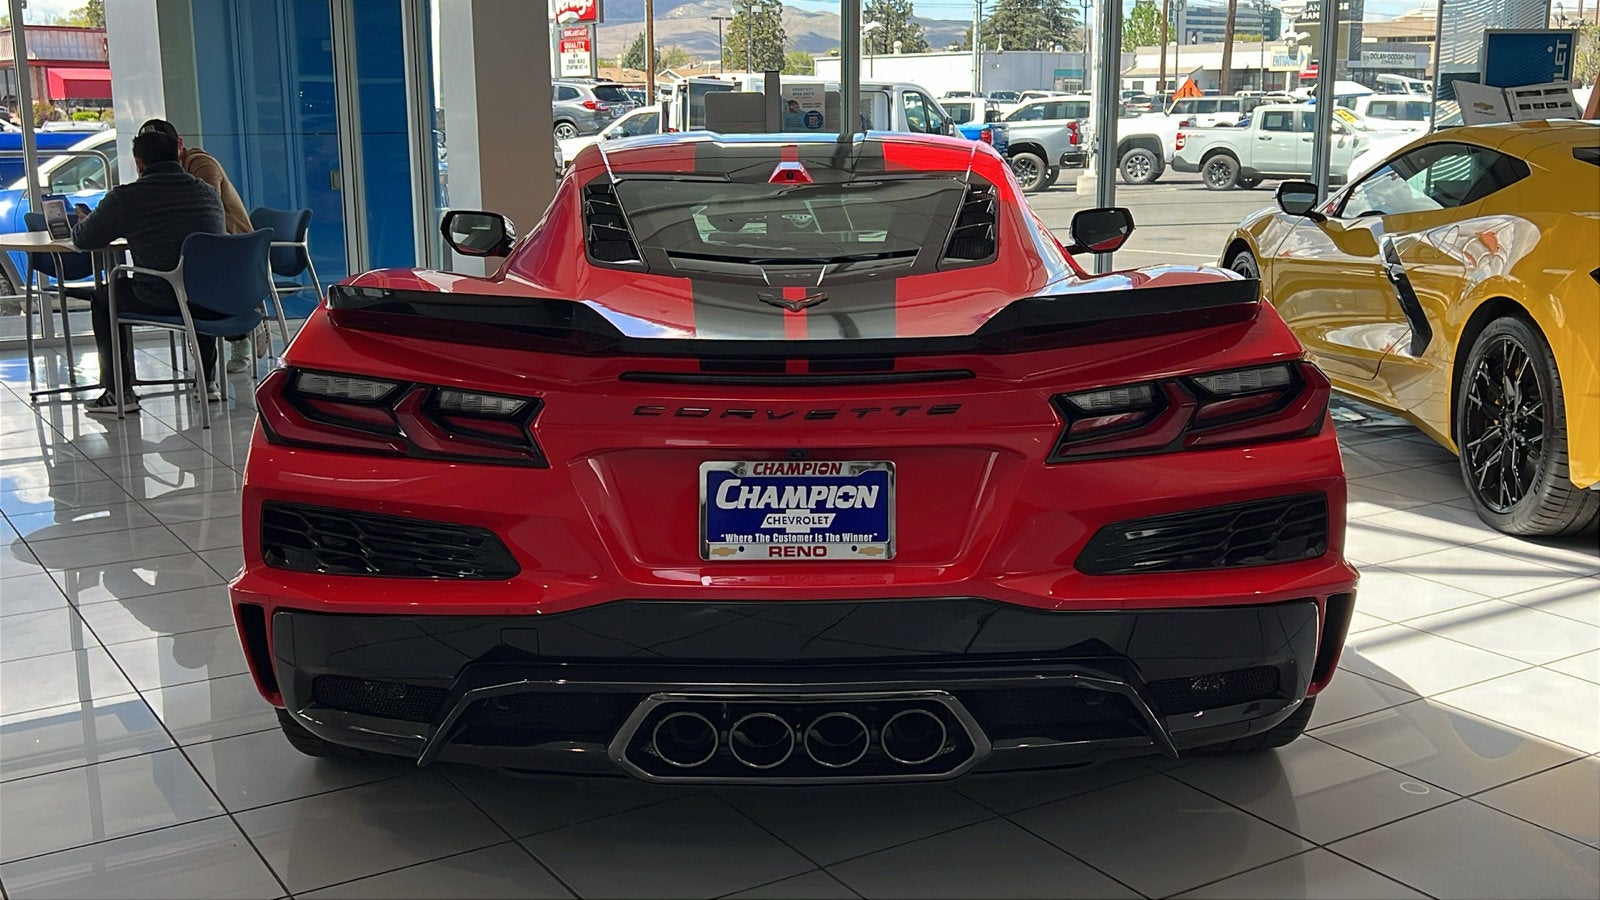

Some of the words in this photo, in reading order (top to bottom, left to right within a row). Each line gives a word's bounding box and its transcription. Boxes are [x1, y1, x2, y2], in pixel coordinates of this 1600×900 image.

[1553, 39, 1567, 82] LET
[632, 403, 963, 420] CORVETTE
[752, 462, 842, 475] CHAMPION
[715, 478, 879, 509] CHAMPION
[766, 516, 830, 525] CHEVROLET
[755, 533, 770, 543] The
[772, 533, 813, 543] Customer
[815, 533, 823, 542] Is
[825, 533, 840, 542] The
[768, 546, 828, 557] RENO
